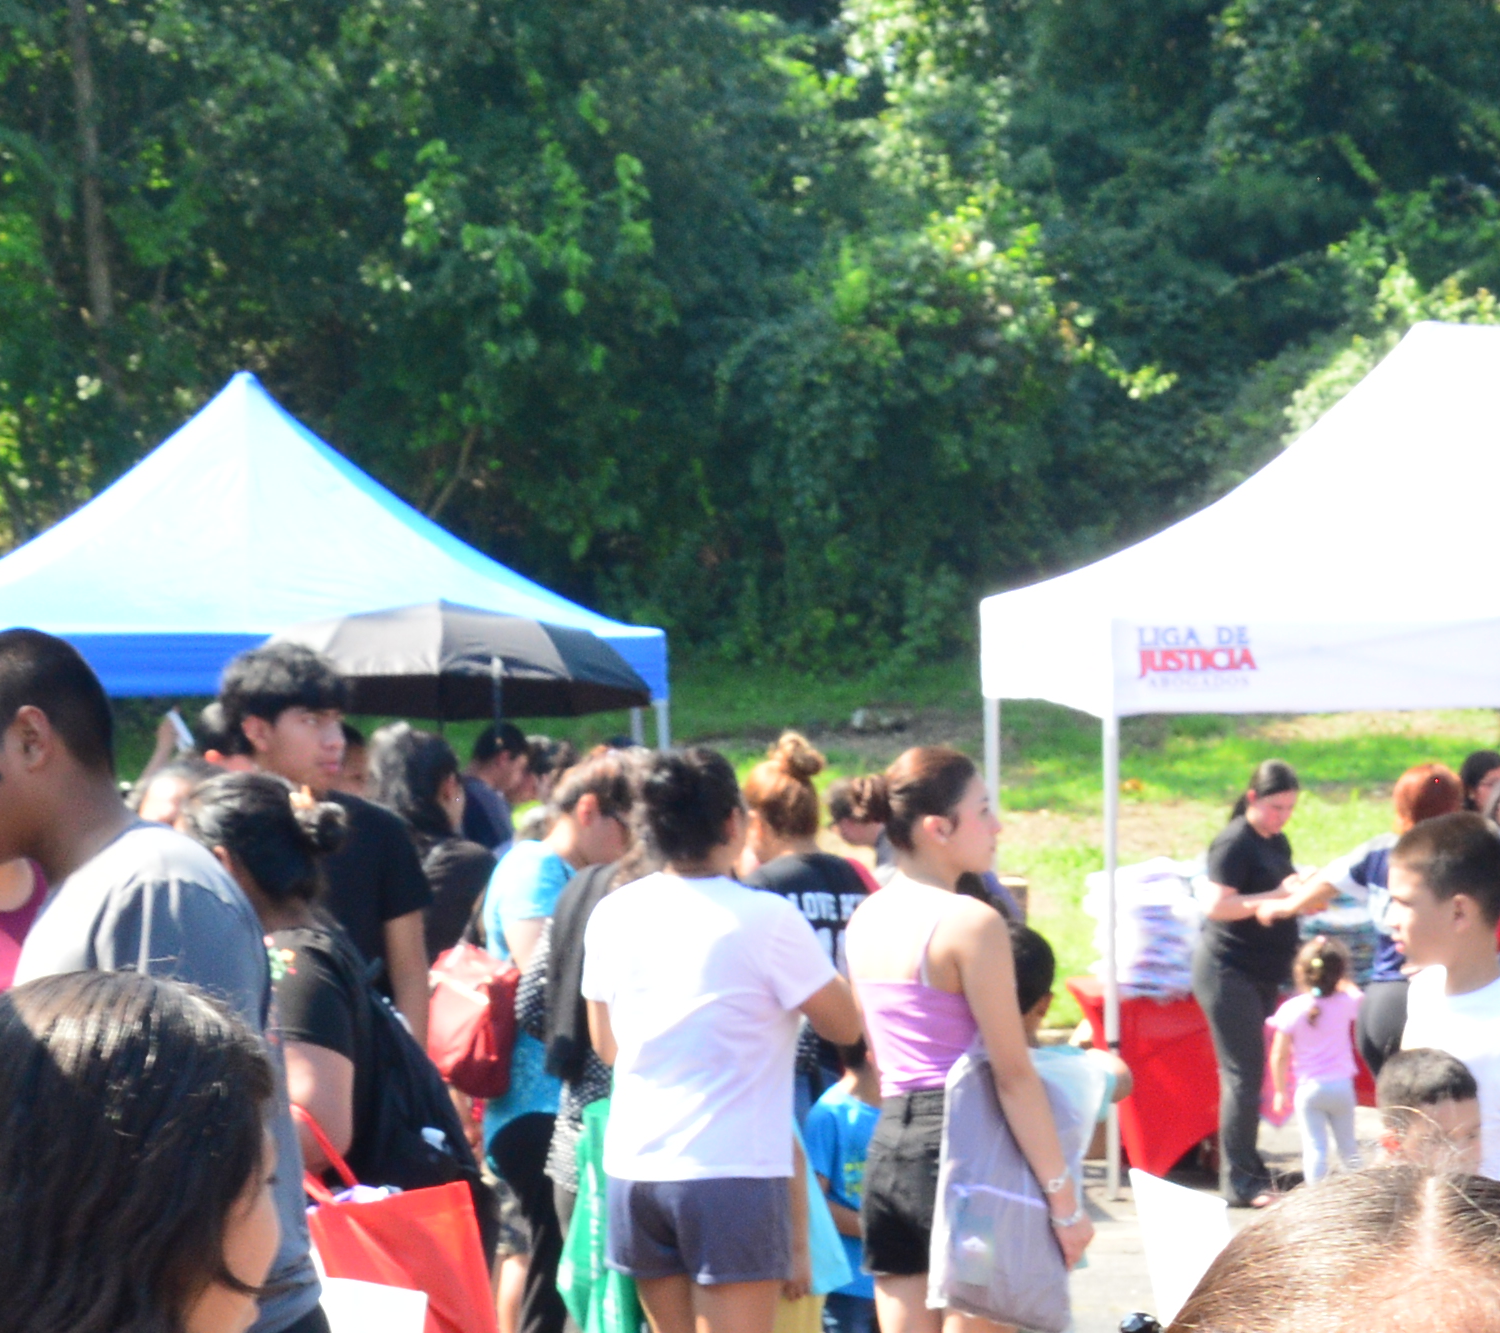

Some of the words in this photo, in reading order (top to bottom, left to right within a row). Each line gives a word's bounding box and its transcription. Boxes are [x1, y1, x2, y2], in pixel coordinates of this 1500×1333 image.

[1137, 626, 1201, 647] LIGA
[1216, 625, 1250, 645] DE
[1139, 648, 1257, 679] JUSTICIA
